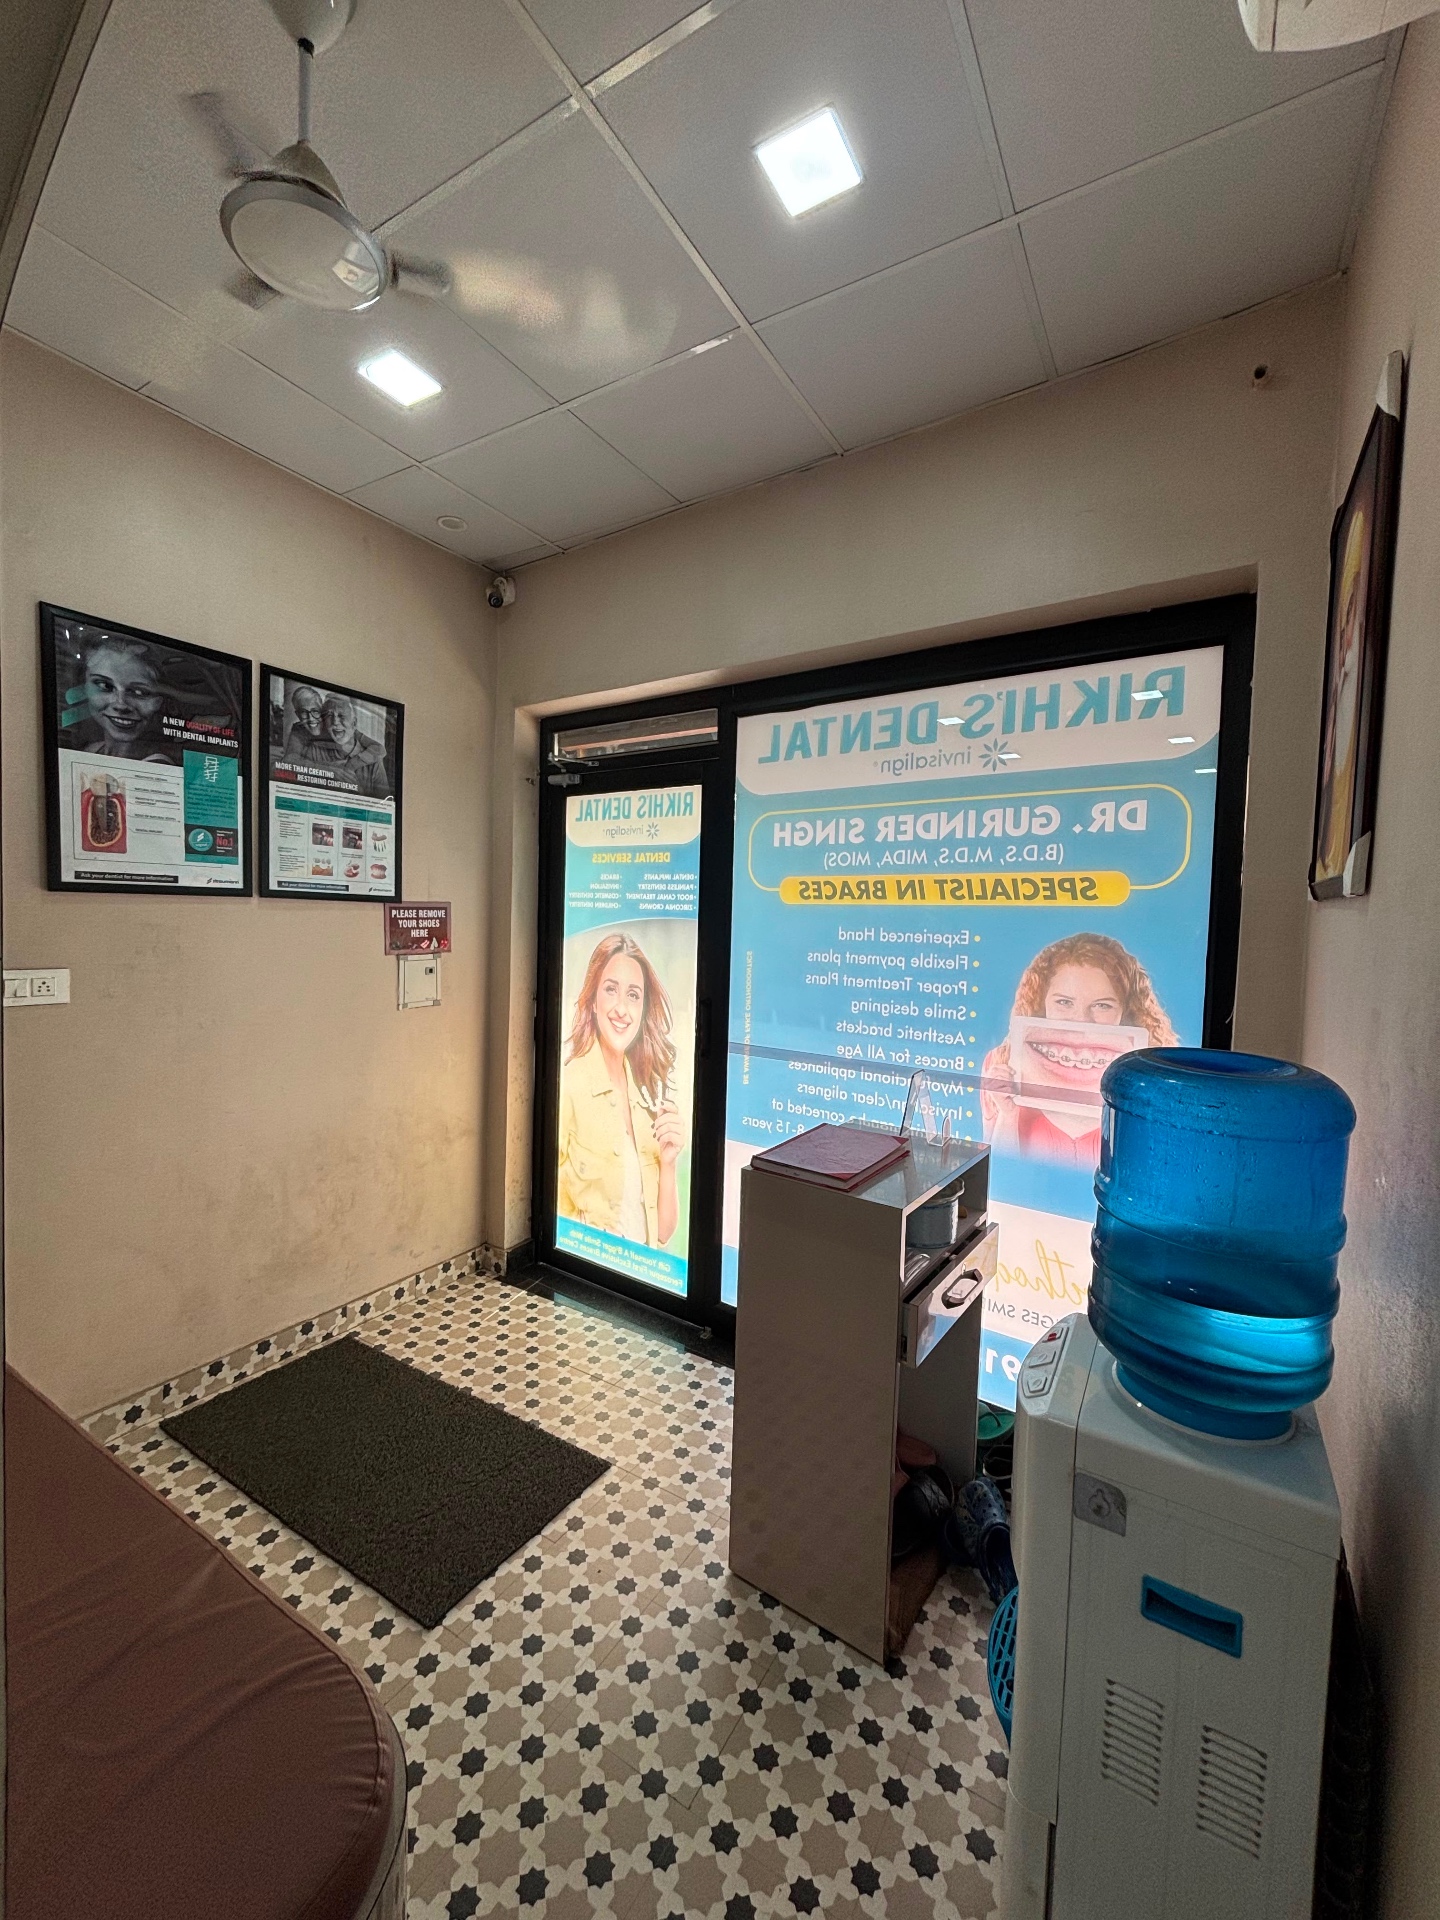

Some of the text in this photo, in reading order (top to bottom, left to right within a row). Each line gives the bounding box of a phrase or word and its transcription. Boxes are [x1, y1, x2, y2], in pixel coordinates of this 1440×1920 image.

[163, 716, 168, 724] A
[169, 717, 185, 727] NEW
[186, 721, 212, 731] QUALITY
[222, 728, 234, 737] LIFE
[163, 727, 239, 748] WITH DENTAL IMPLANTS
[275, 762, 335, 778] MORE THAN CREATING
[297, 774, 327, 786] RESTORING
[328, 780, 359, 792] CONFIDENCE
[391, 909, 446, 918] PLEASE REMOVE
[398, 919, 440, 928] YOUR SHOES
[411, 929, 429, 937] HERE
